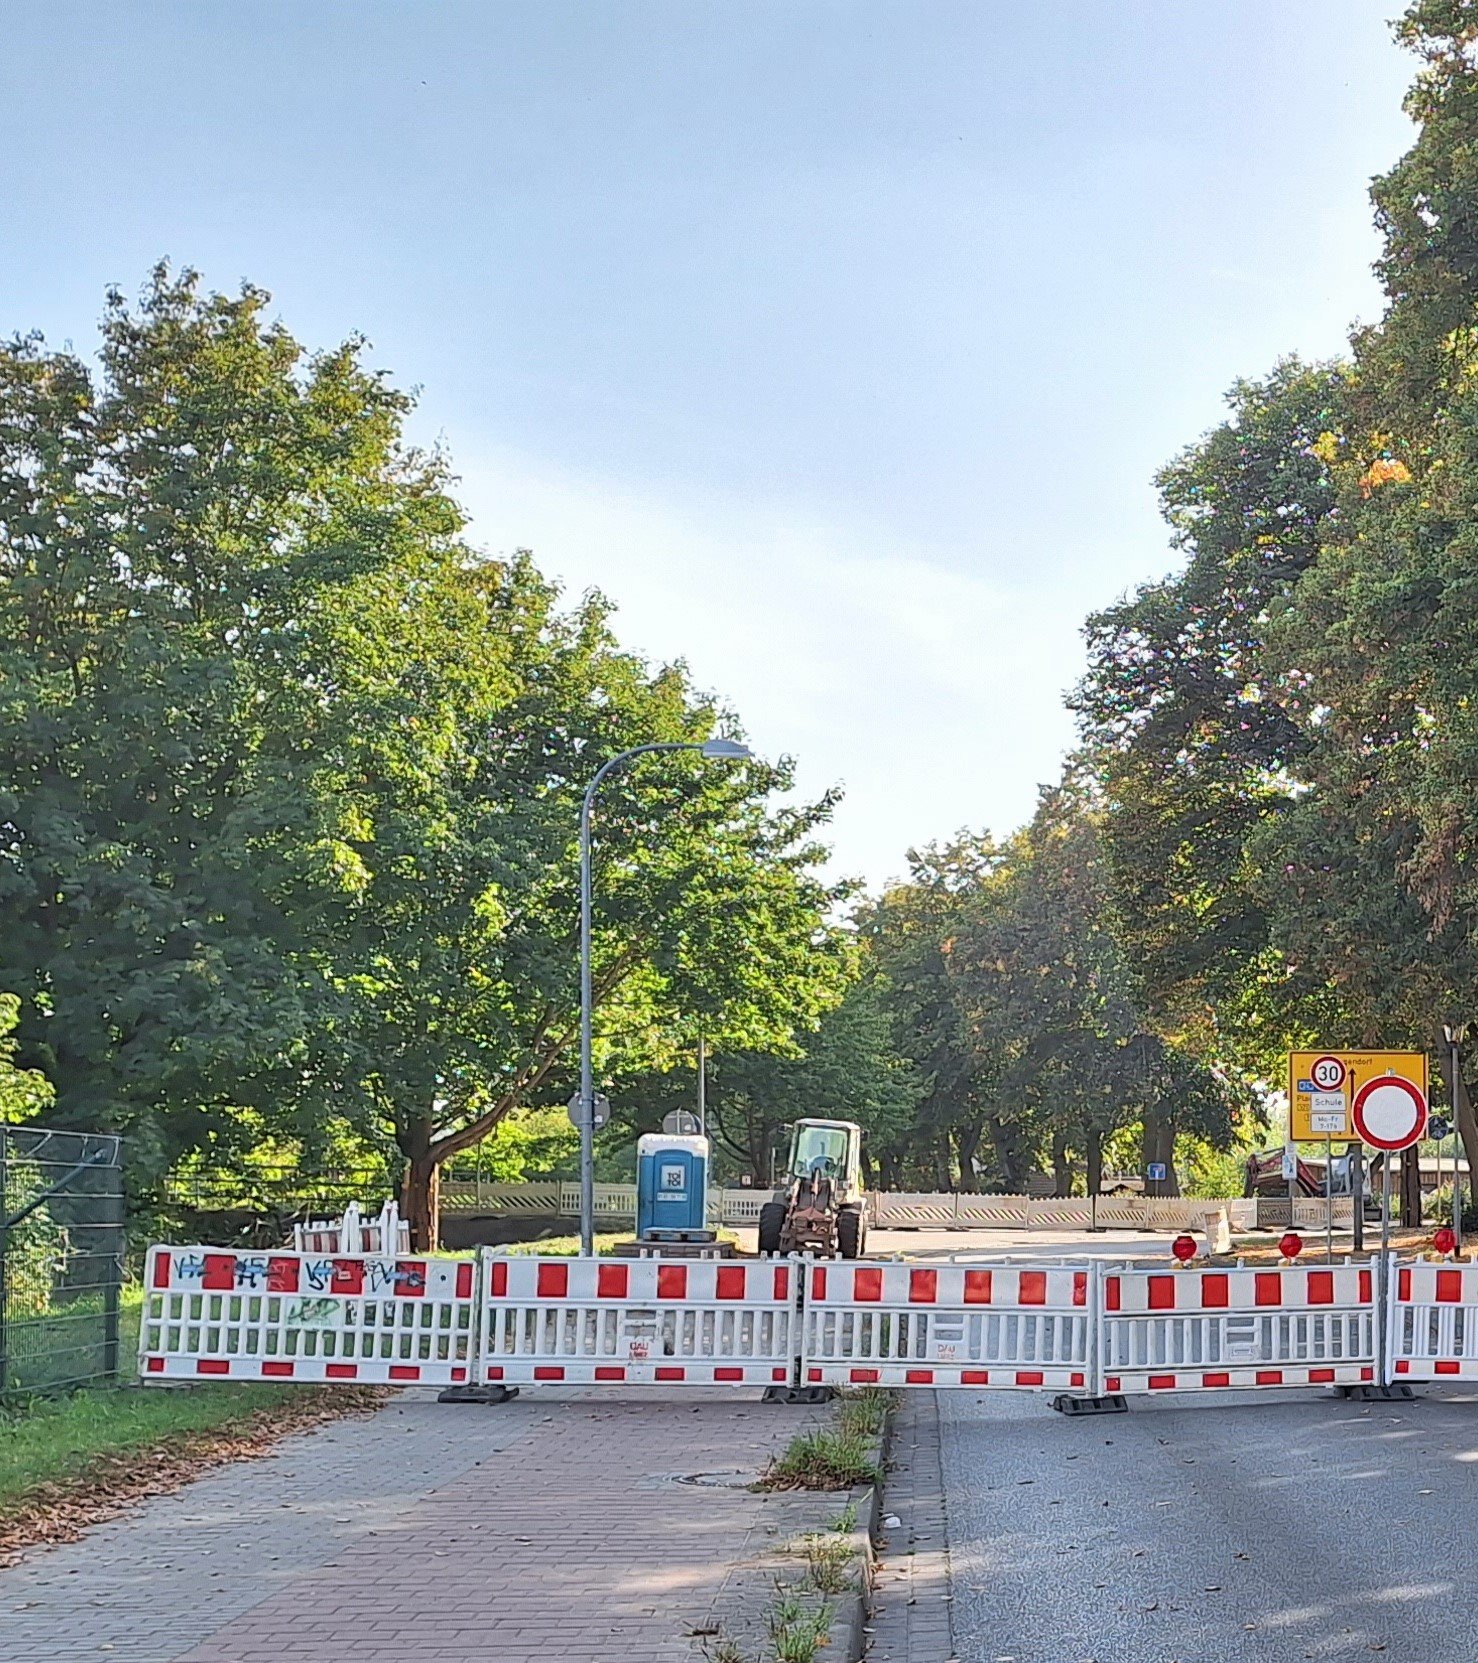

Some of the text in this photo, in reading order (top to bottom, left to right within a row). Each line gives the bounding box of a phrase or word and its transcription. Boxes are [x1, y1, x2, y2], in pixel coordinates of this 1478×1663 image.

[1343, 1058, 1373, 1066] gendorf
[1318, 1066, 1338, 1082] 30
[1315, 1098, 1343, 1106] Schule
